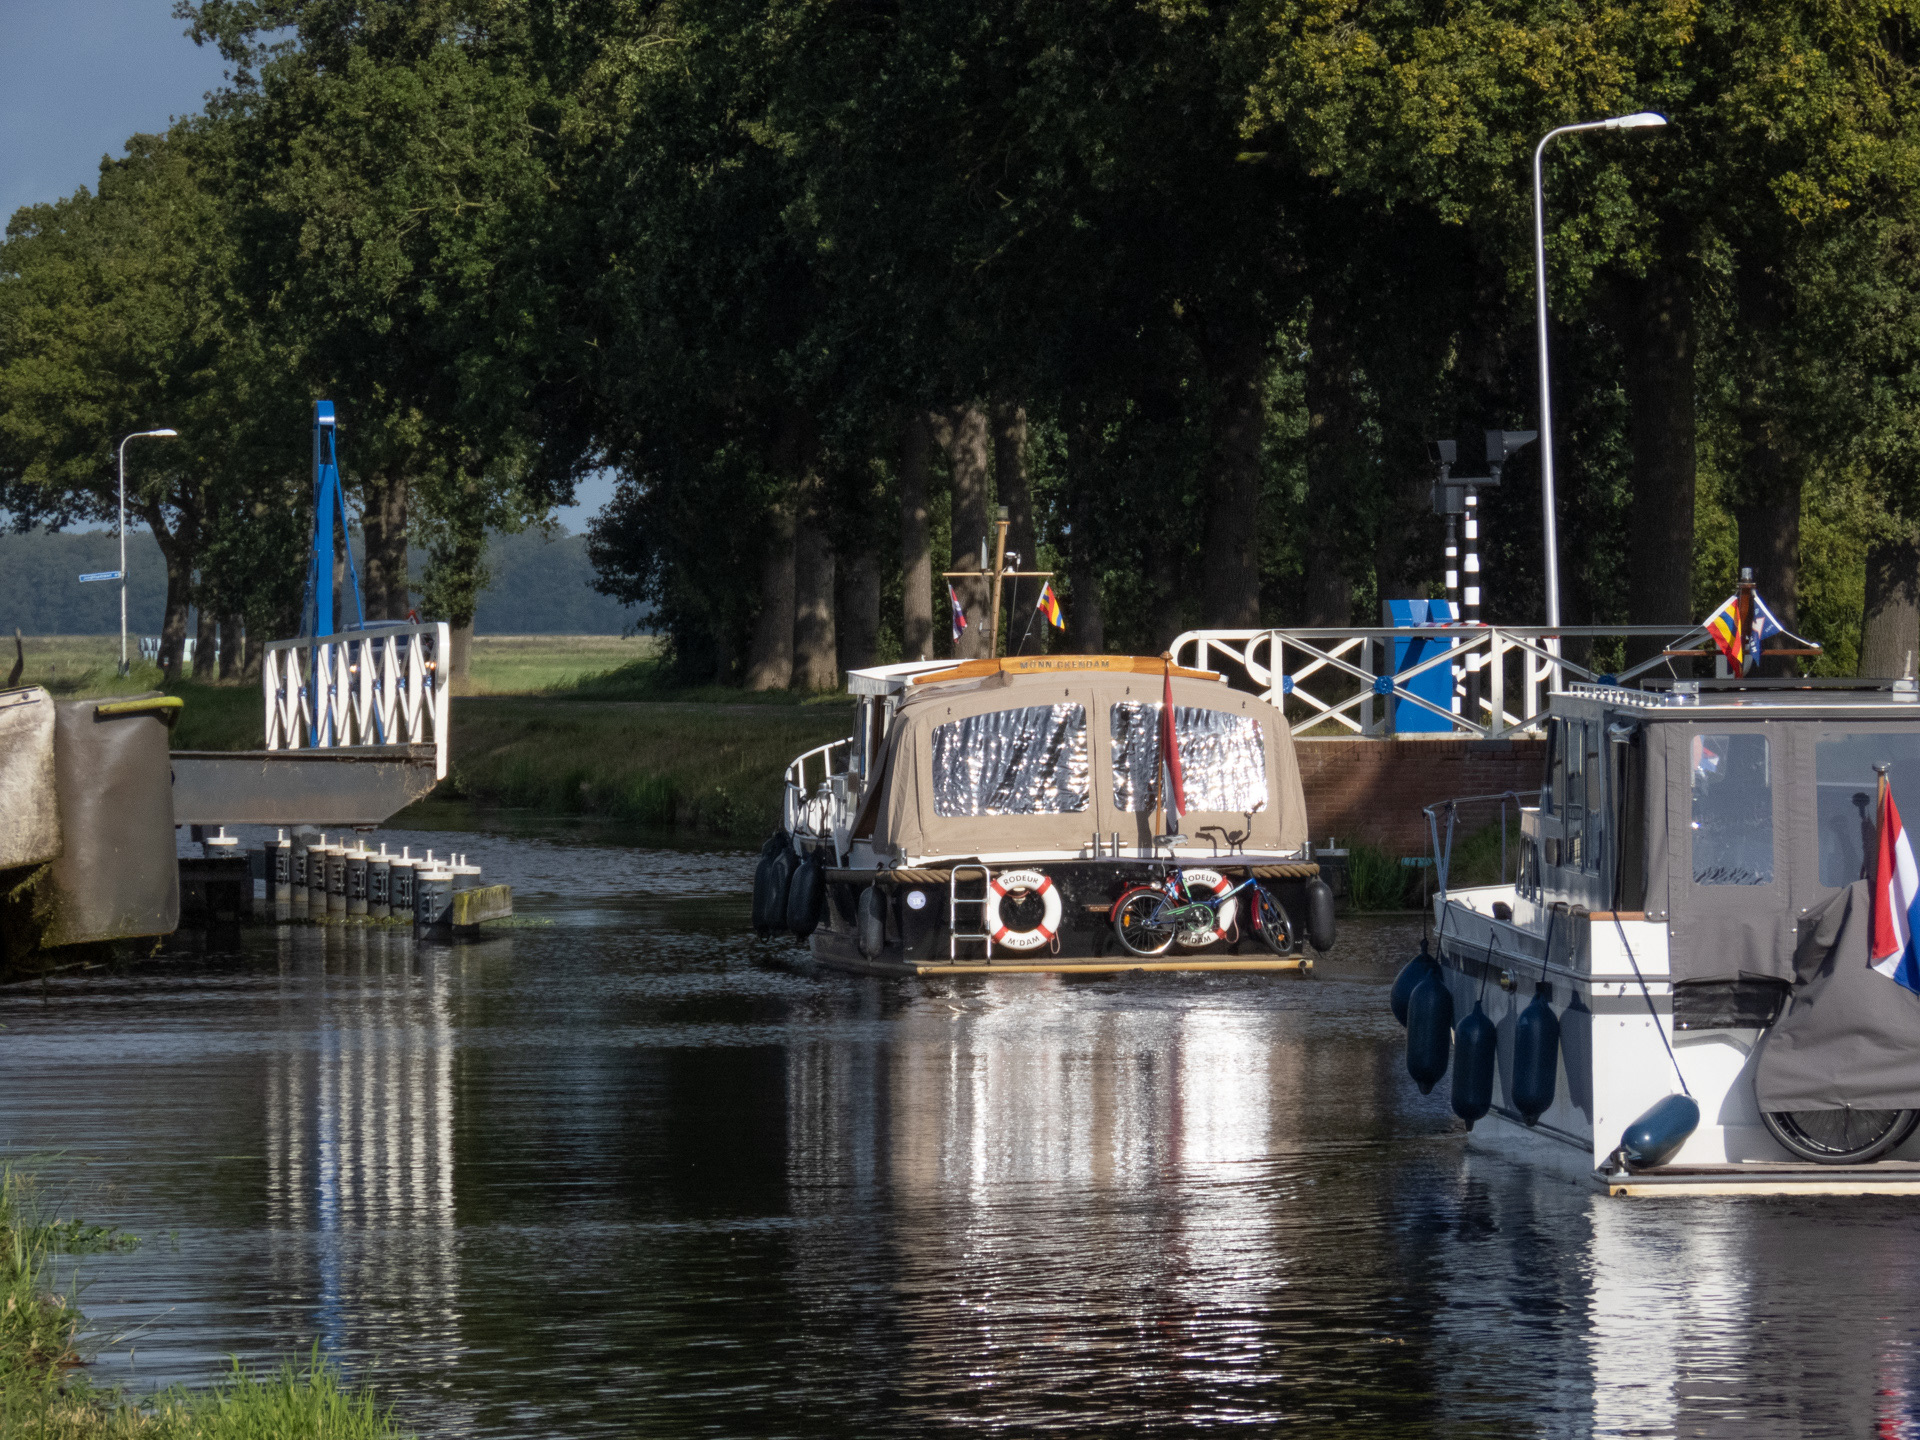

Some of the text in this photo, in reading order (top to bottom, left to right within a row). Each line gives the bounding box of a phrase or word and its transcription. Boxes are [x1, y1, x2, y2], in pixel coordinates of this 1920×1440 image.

[1020, 660, 1110, 669] MONNCKENDAM
[1003, 874, 1039, 885] RODEUR
[1007, 936, 1040, 946] M'DAM
